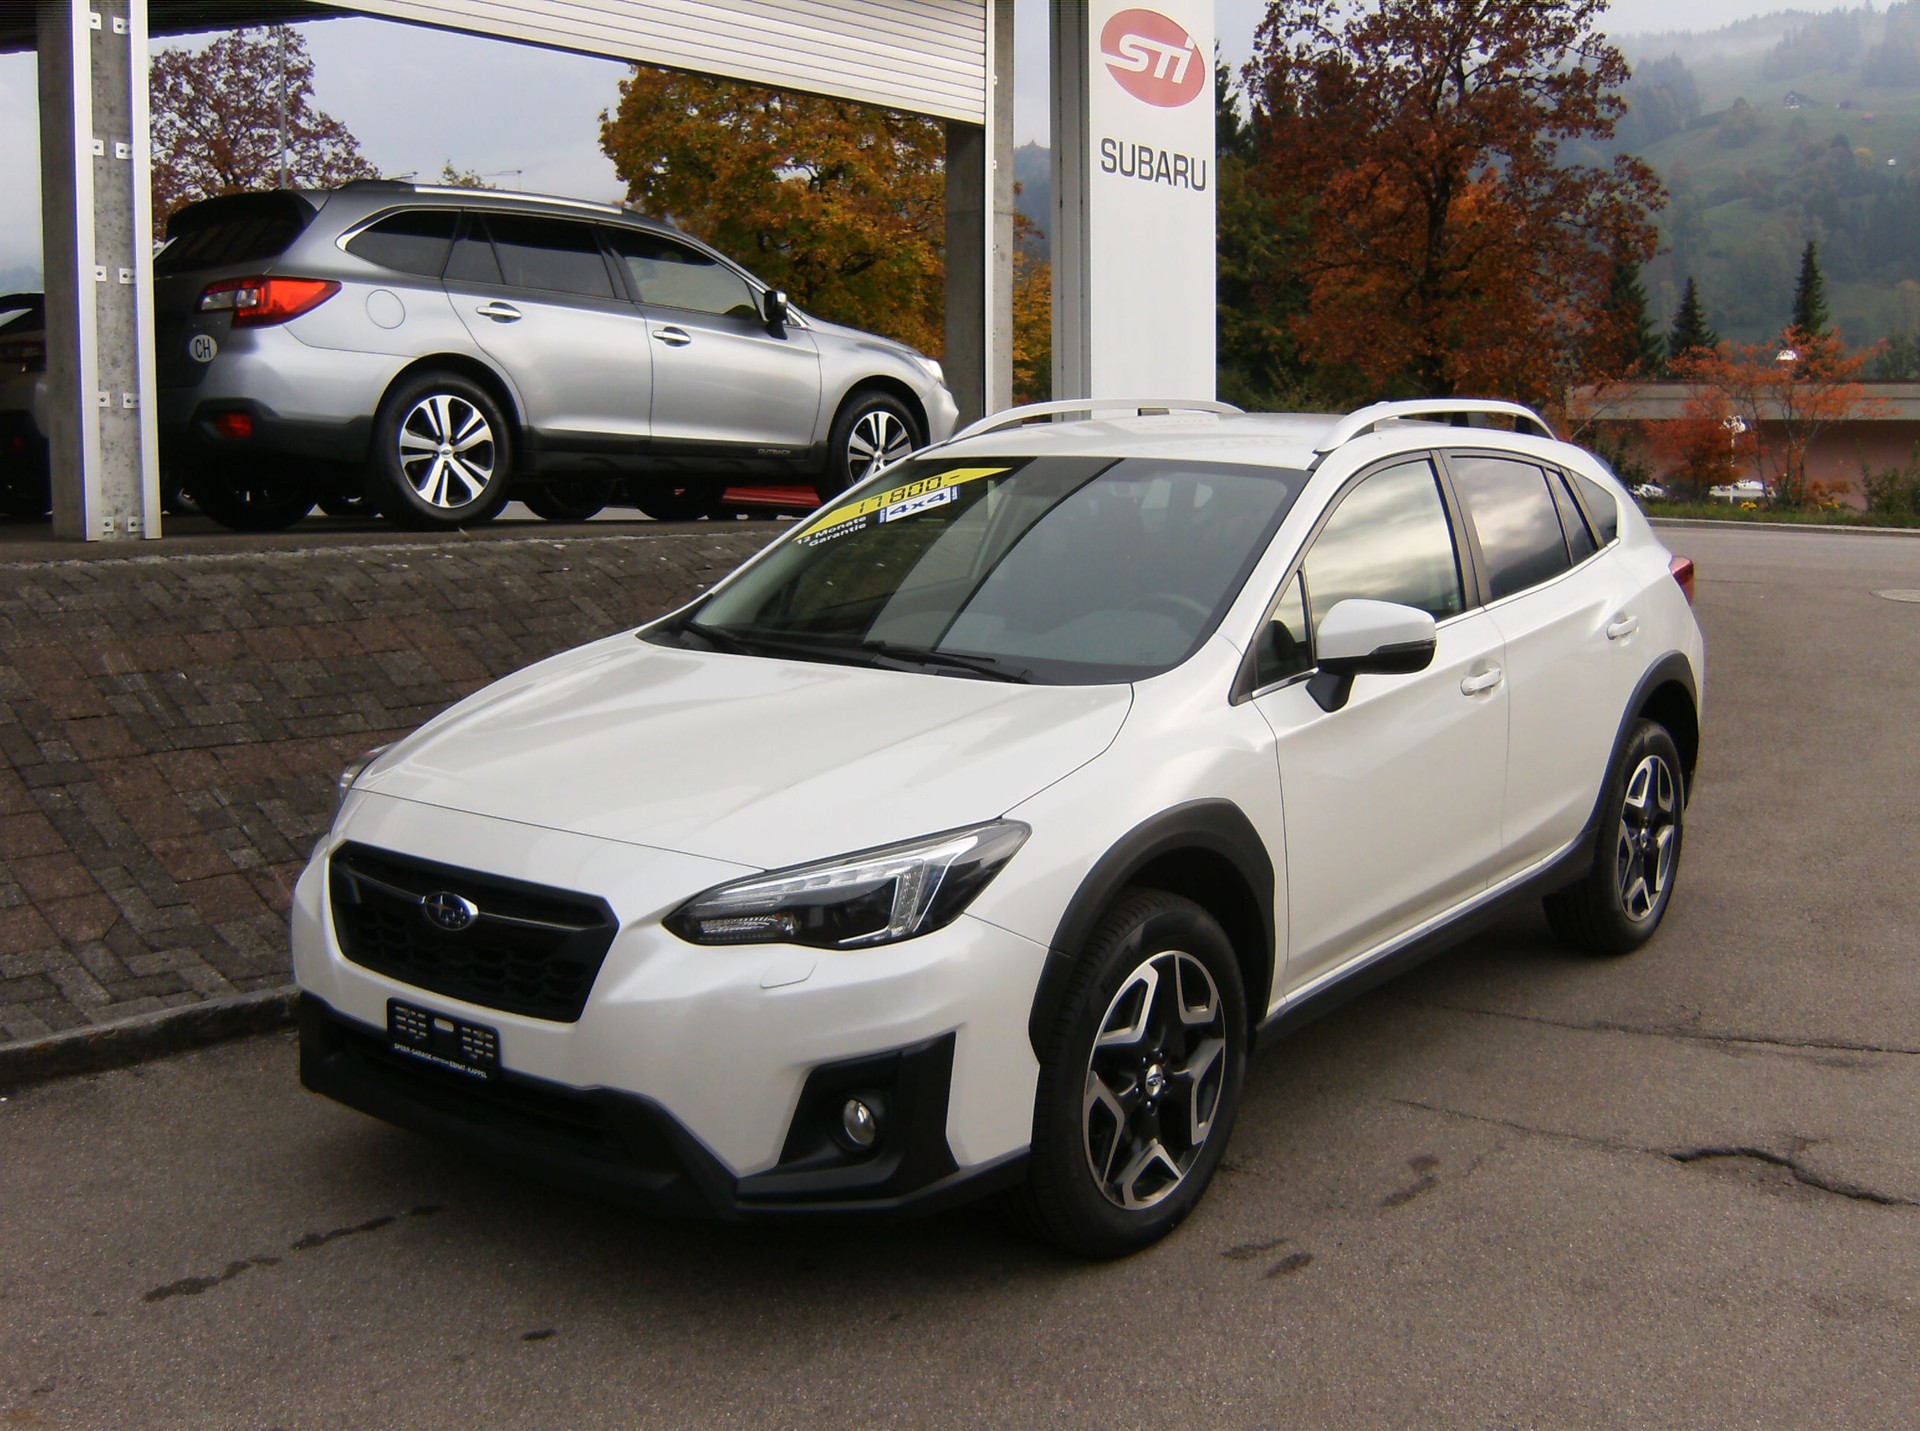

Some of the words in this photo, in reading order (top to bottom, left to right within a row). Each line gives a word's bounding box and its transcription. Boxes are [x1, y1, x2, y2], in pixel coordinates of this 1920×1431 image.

[1100, 137, 1207, 192] SUBARU
[195, 338, 212, 359] CH
[808, 522, 868, 548] Garantie
[814, 515, 868, 538] Monate
